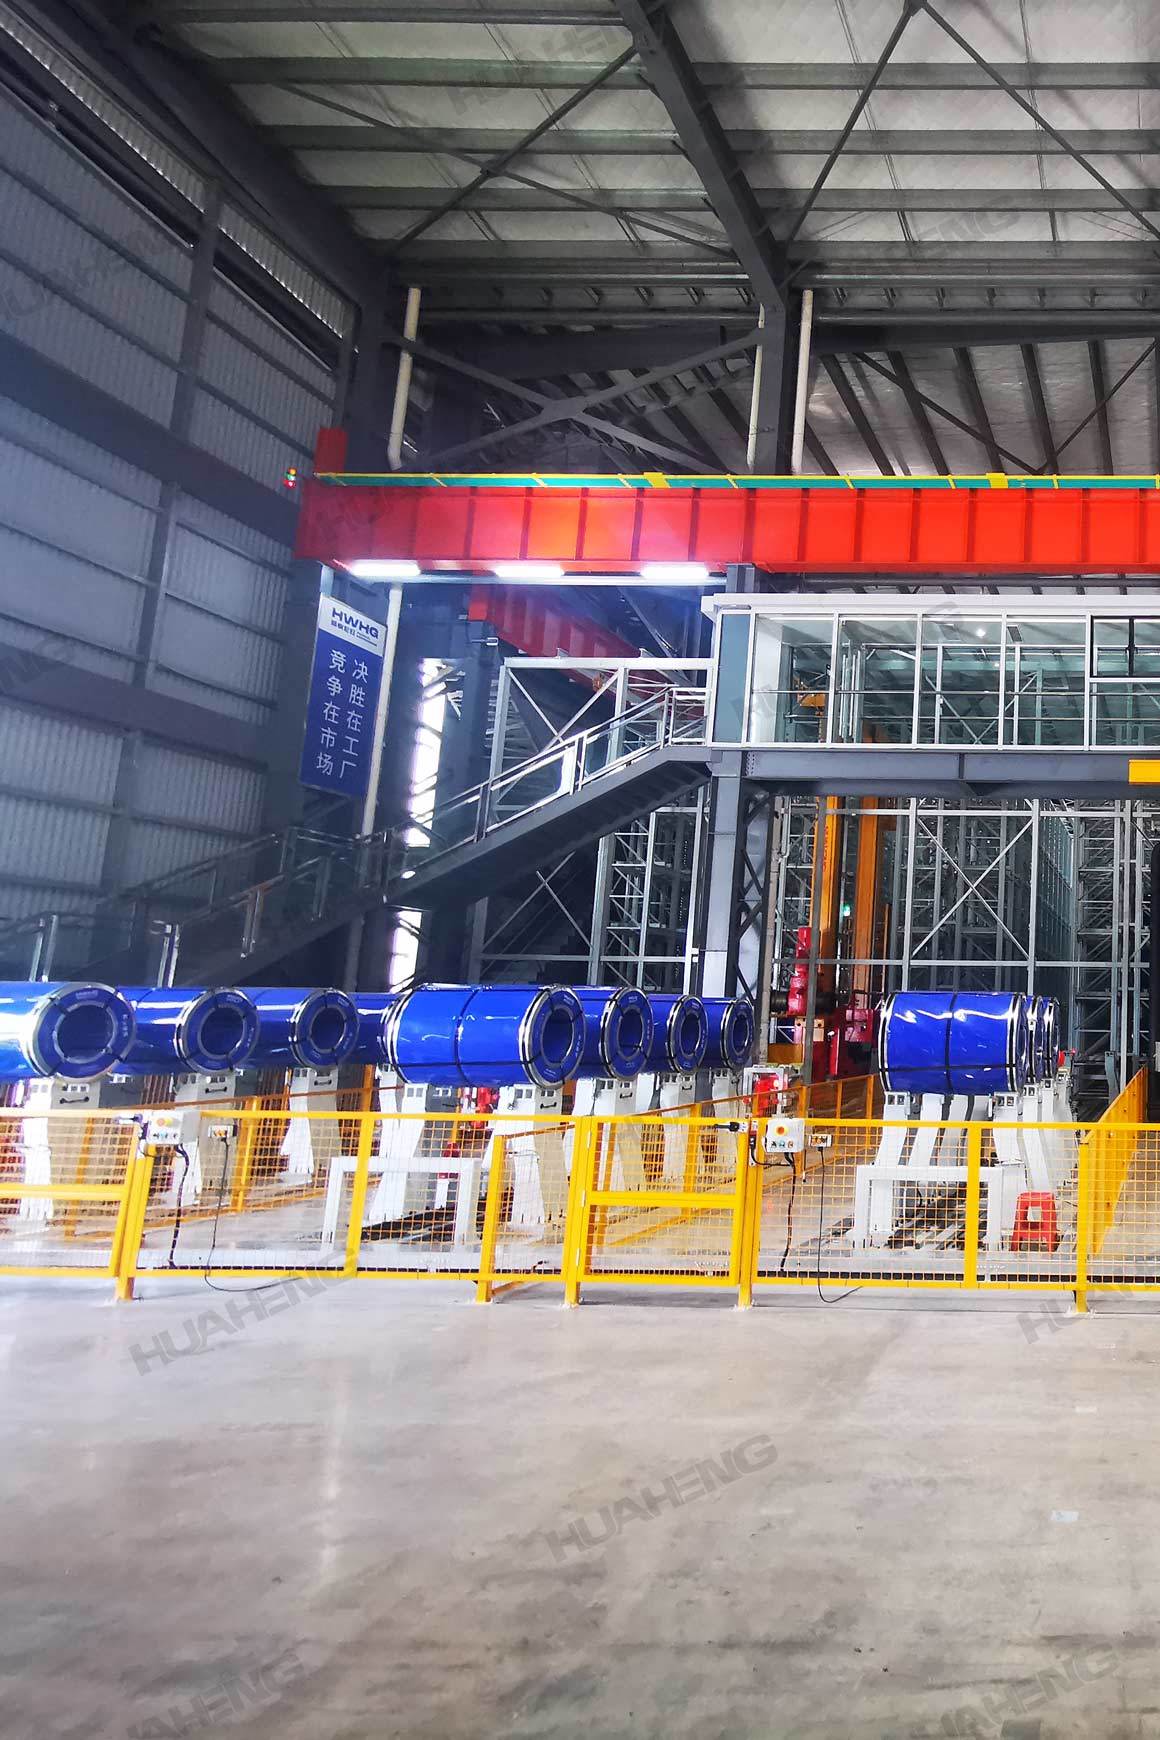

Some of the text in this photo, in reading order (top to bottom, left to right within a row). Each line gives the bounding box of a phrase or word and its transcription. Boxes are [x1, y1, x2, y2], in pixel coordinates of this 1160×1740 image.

[331, 607, 379, 639] HWHG
[316, 649, 348, 777] 竞争在市场
[339, 659, 369, 779] 决胜在工厂
